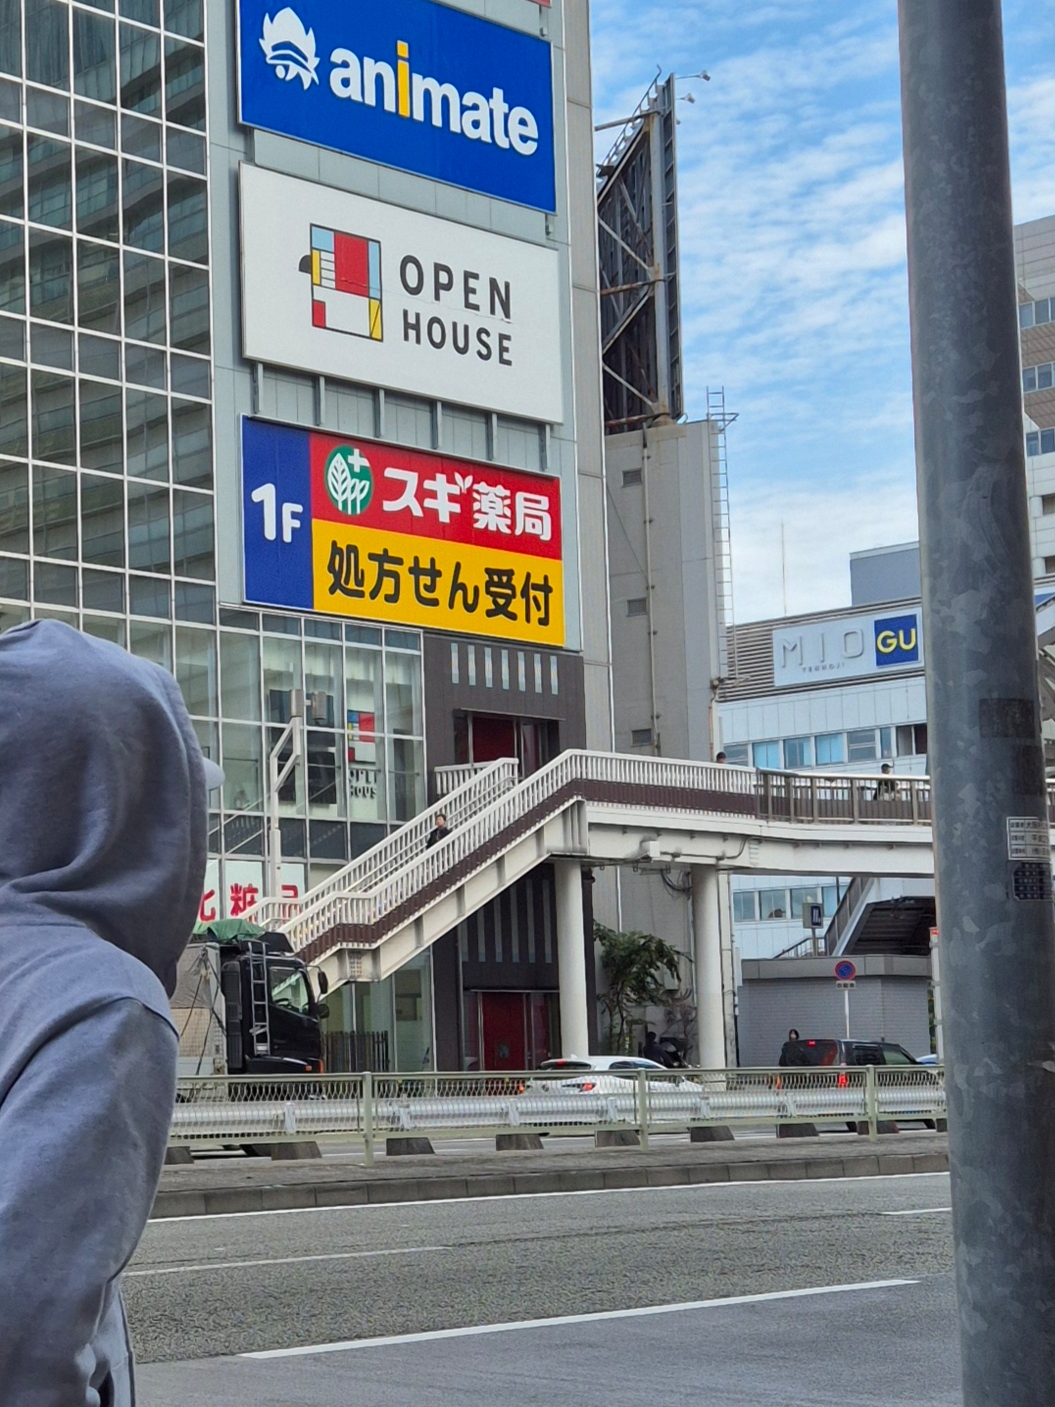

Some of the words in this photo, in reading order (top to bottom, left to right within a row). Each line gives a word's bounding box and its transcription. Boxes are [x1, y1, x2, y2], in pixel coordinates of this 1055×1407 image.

[330, 40, 539, 156] animate
[400, 255, 511, 320] OPEN
[403, 308, 512, 366] HOUSE
[251, 483, 303, 543] 1F
[382, 467, 552, 541] スギ薬局
[327, 540, 553, 627] 処方せん受付
[781, 629, 864, 669] MIO
[876, 628, 916, 653] GU
